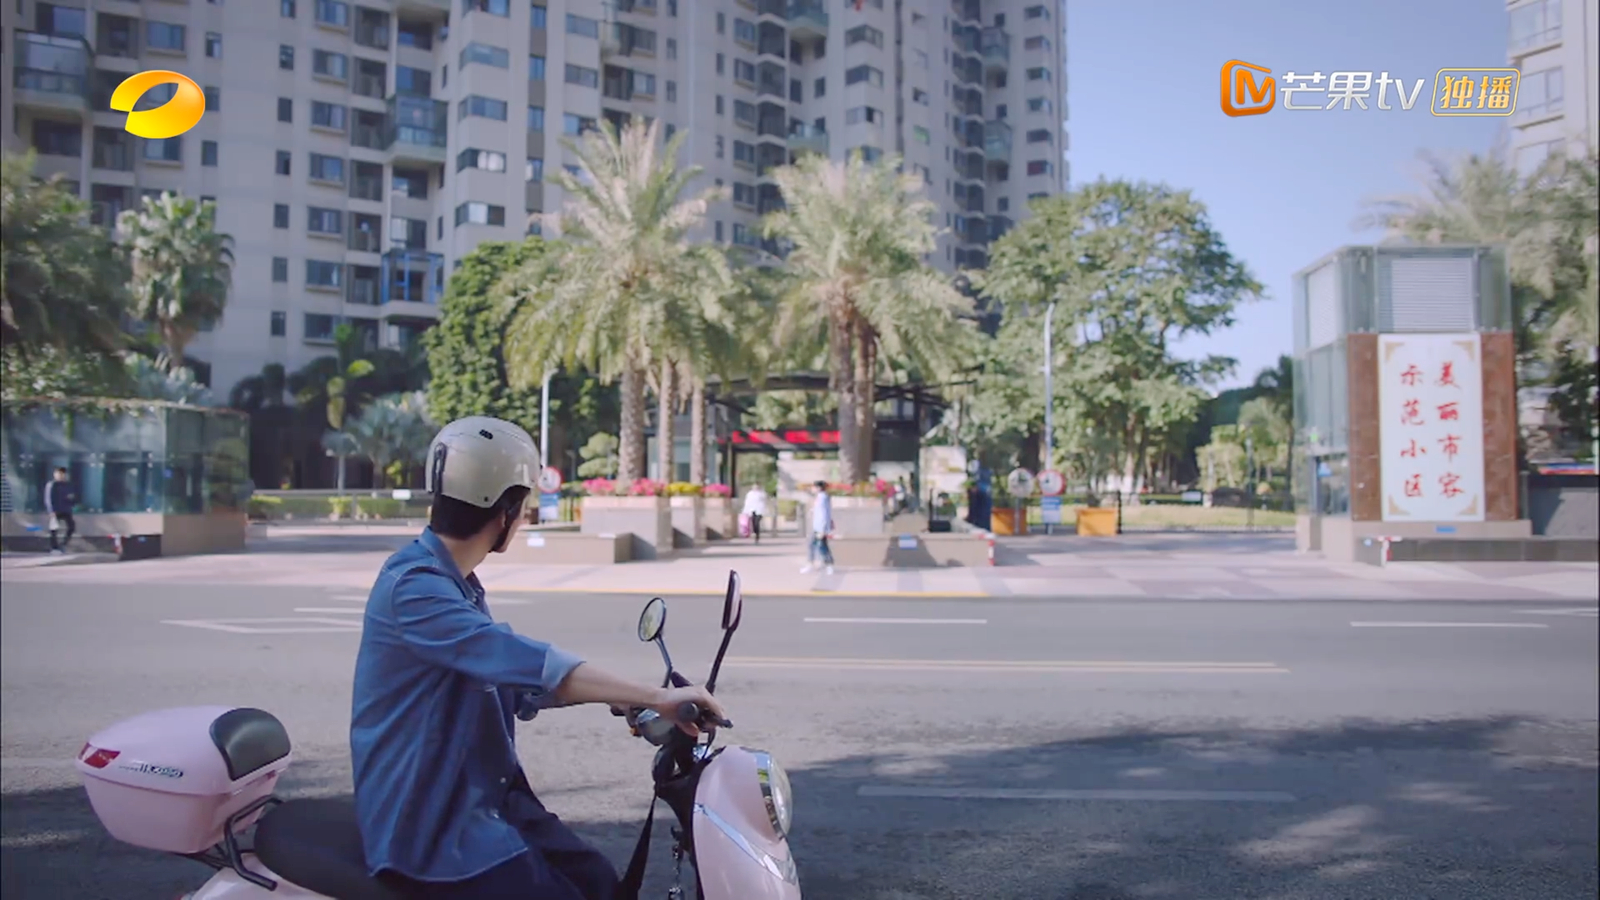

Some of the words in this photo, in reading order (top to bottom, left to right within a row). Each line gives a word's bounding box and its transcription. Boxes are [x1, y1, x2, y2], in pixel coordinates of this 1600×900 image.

[1400, 364, 1425, 497] 示范小区
[1435, 361, 1464, 498] 美丽市容
